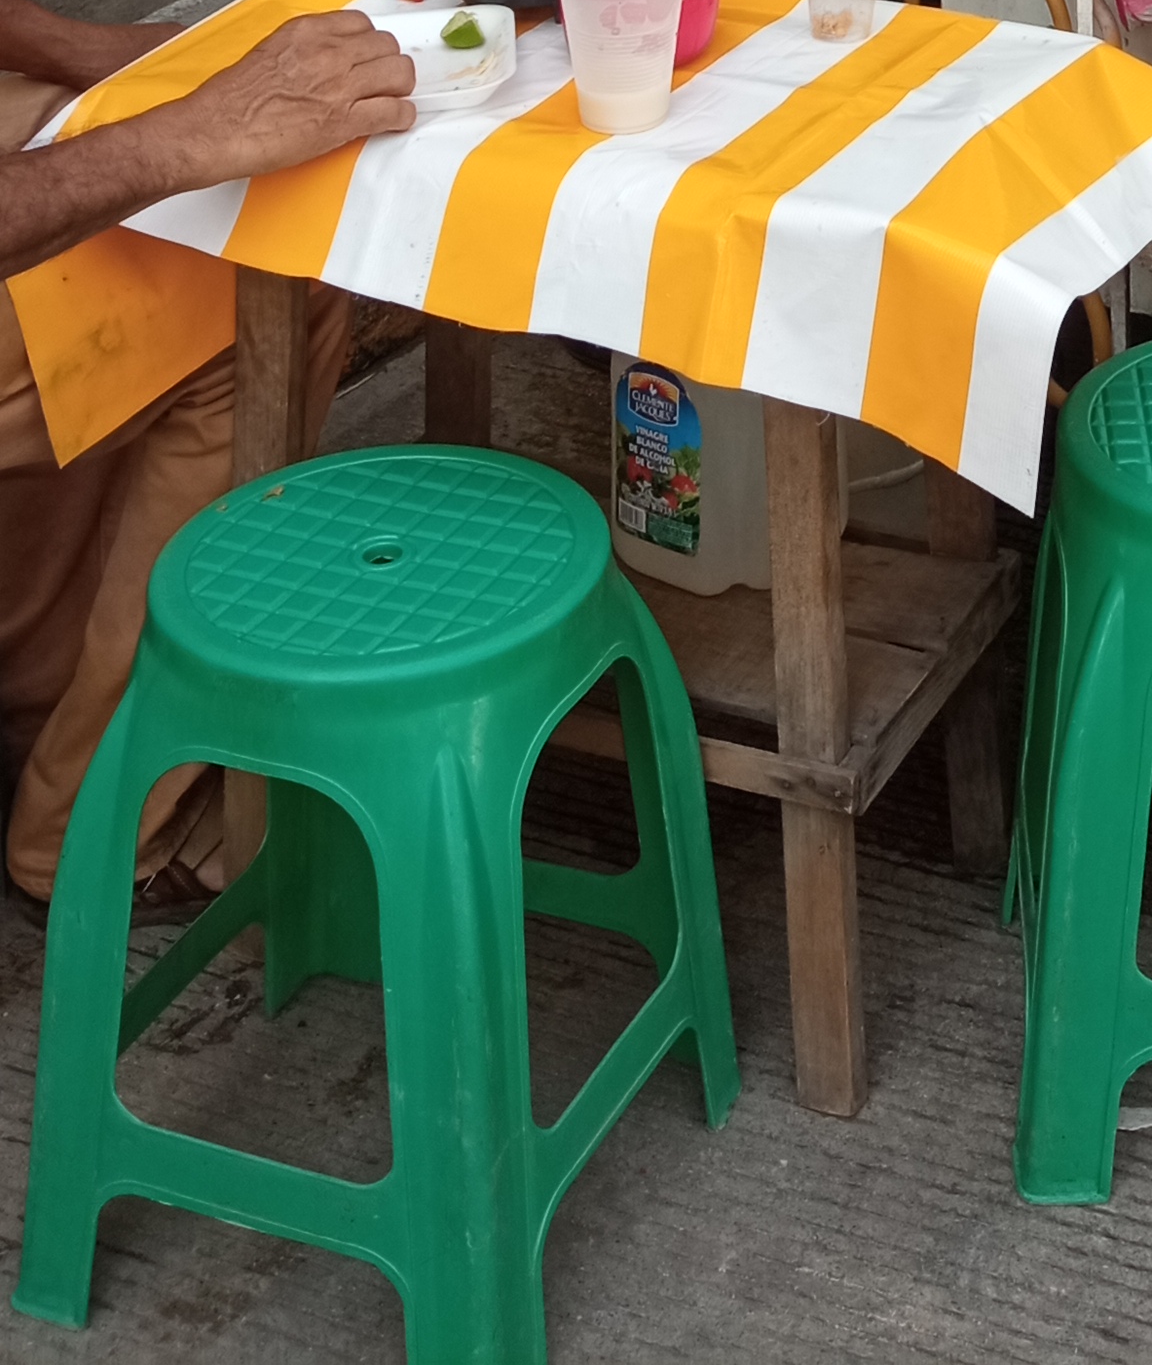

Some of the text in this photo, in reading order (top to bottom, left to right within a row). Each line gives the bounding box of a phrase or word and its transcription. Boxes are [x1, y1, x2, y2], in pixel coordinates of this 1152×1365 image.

[632, 389, 675, 412] CLEMENTE
[634, 401, 671, 422] JACQUES
[636, 424, 669, 444] VINAGRE
[628, 443, 676, 467] DE ALCOHOL
[636, 436, 668, 454] BLANCO
